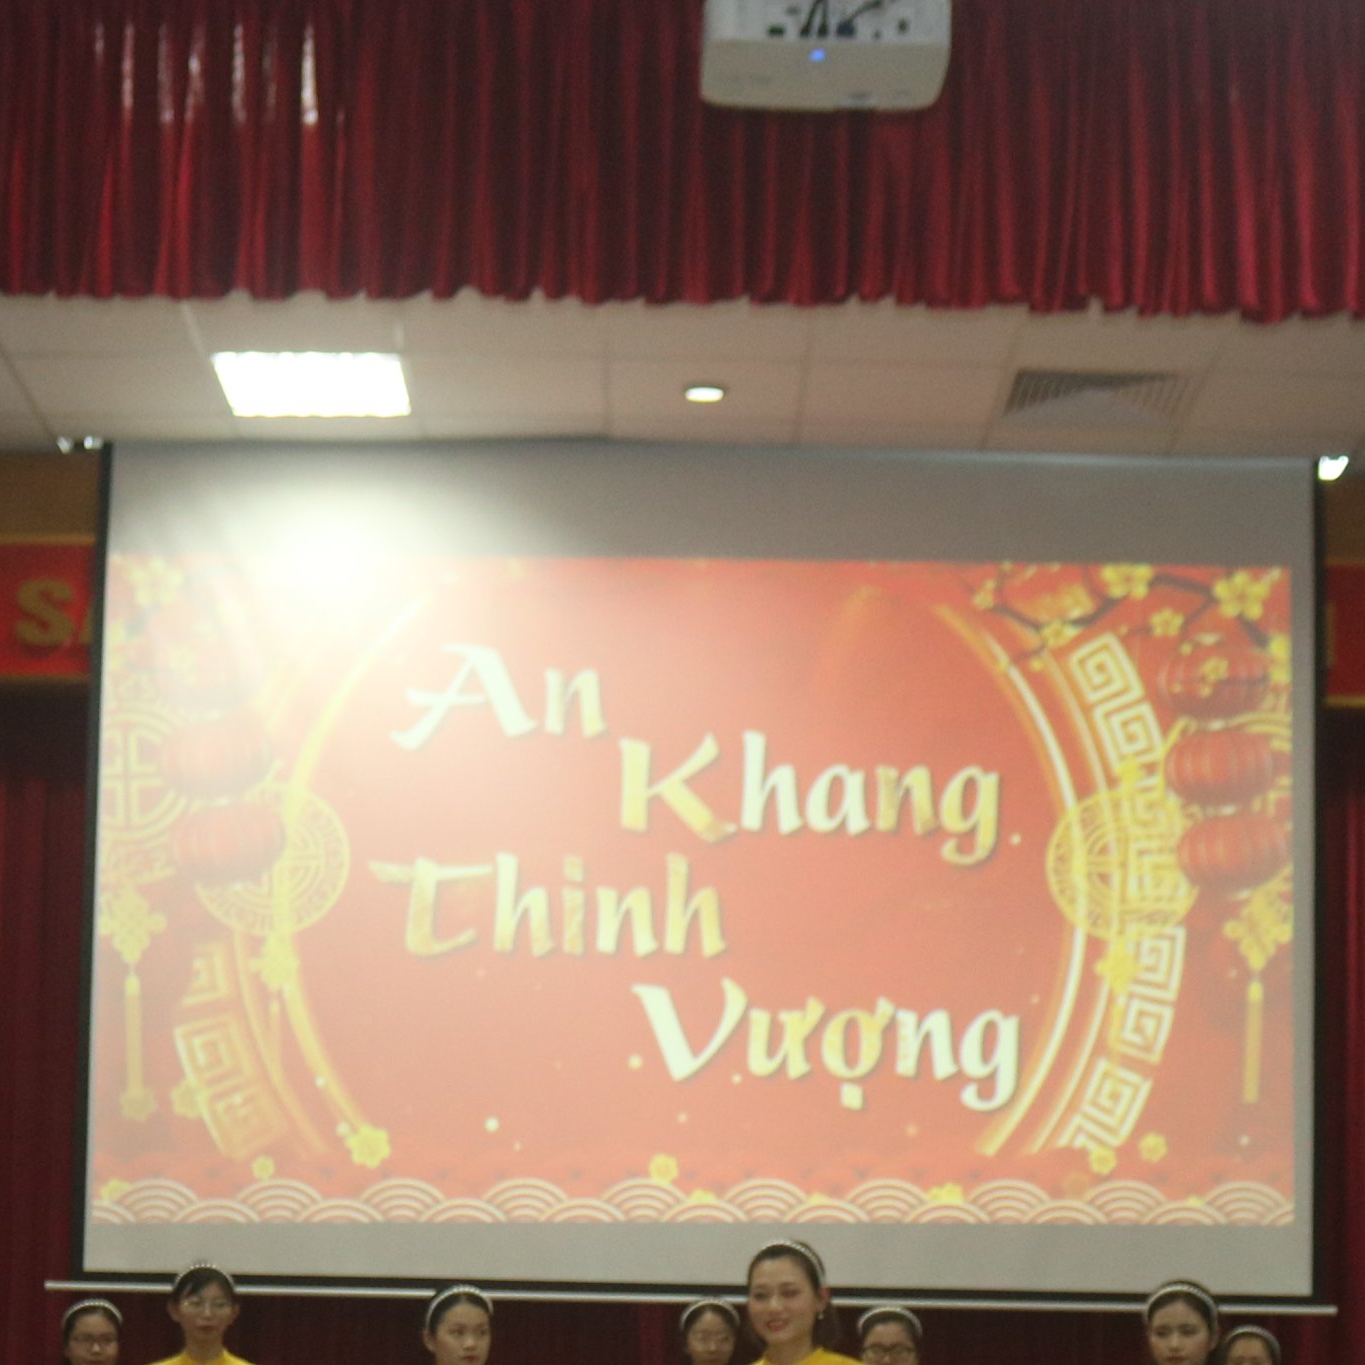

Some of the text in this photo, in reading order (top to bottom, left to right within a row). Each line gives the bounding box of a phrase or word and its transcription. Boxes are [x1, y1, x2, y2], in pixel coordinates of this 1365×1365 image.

[390, 643, 607, 751] An
[619, 730, 1001, 866] Khang
[632, 976, 1021, 1112] Vượng
